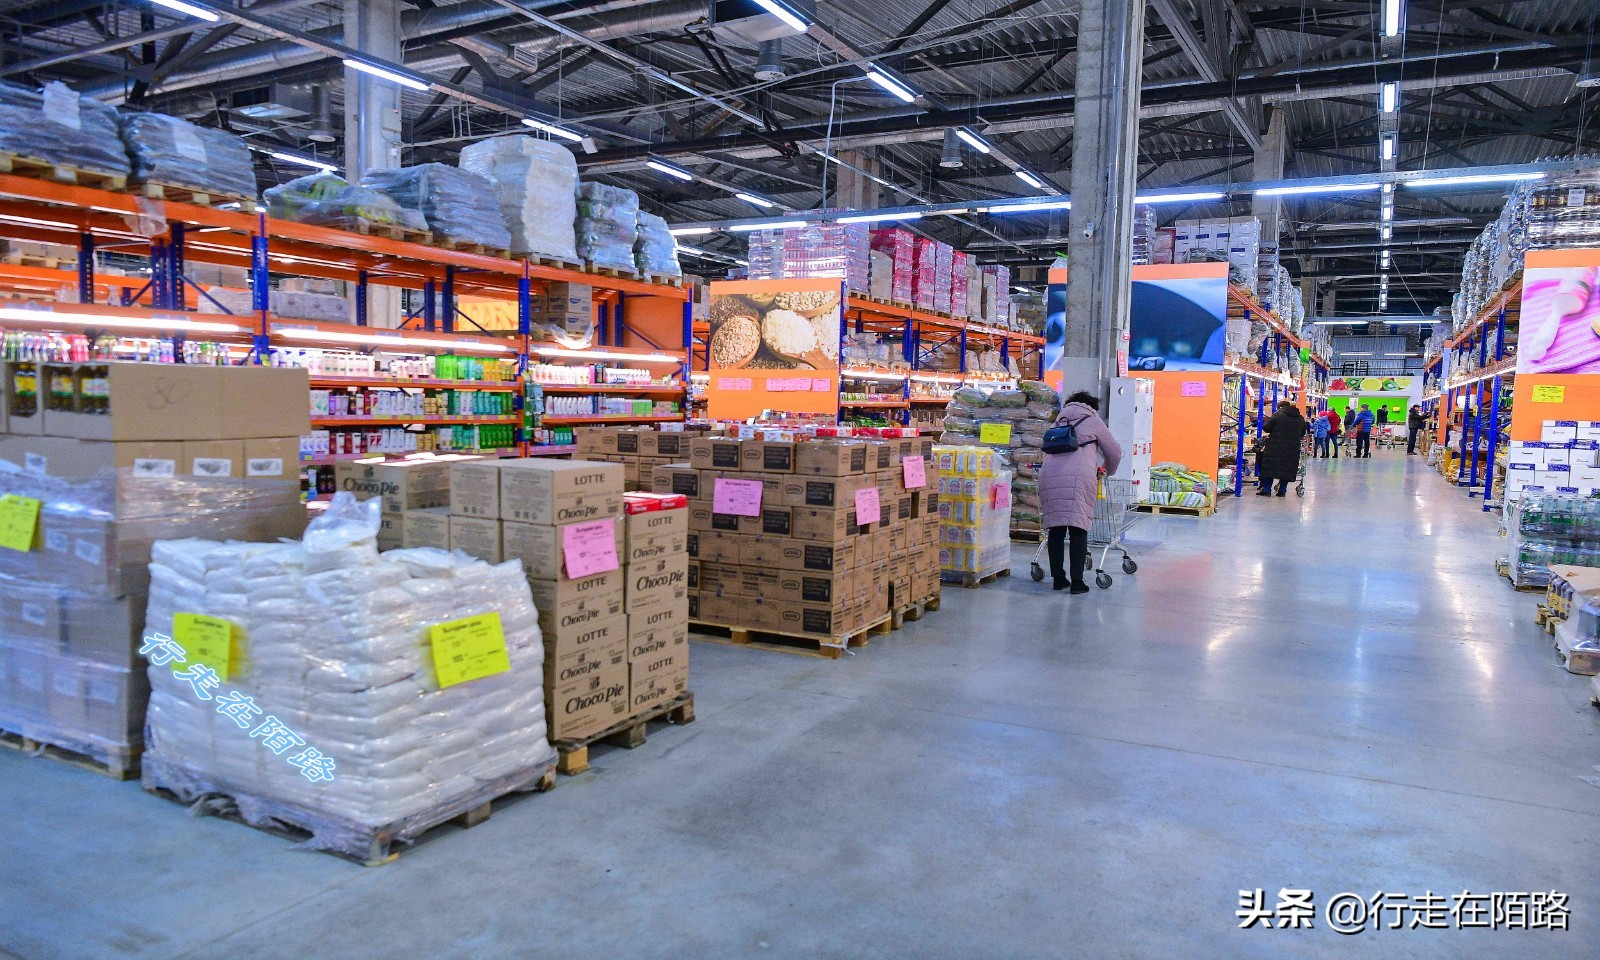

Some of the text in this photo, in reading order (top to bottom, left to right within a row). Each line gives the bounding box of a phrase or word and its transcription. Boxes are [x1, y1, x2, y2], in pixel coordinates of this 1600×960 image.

[343, 477, 400, 497] Choco Pie
[574, 473, 606, 486] LOTTE
[558, 505, 599, 521] Choco Pie
[647, 516, 673, 528] LOTTE
[633, 545, 666, 560] Choco Pie
[577, 576, 607, 592] LOTTE
[636, 570, 685, 592] Choco Pie
[561, 608, 600, 628] Choco Pie
[647, 610, 673, 625] LOTTE
[576, 627, 609, 645] LOTTE
[632, 639, 667, 657] Choco Pie
[560, 659, 602, 681] Choco Pie
[648, 656, 674, 672] LOTTE
[565, 684, 625, 715] Choco Pie
[634, 686, 667, 706] Choco Pie
